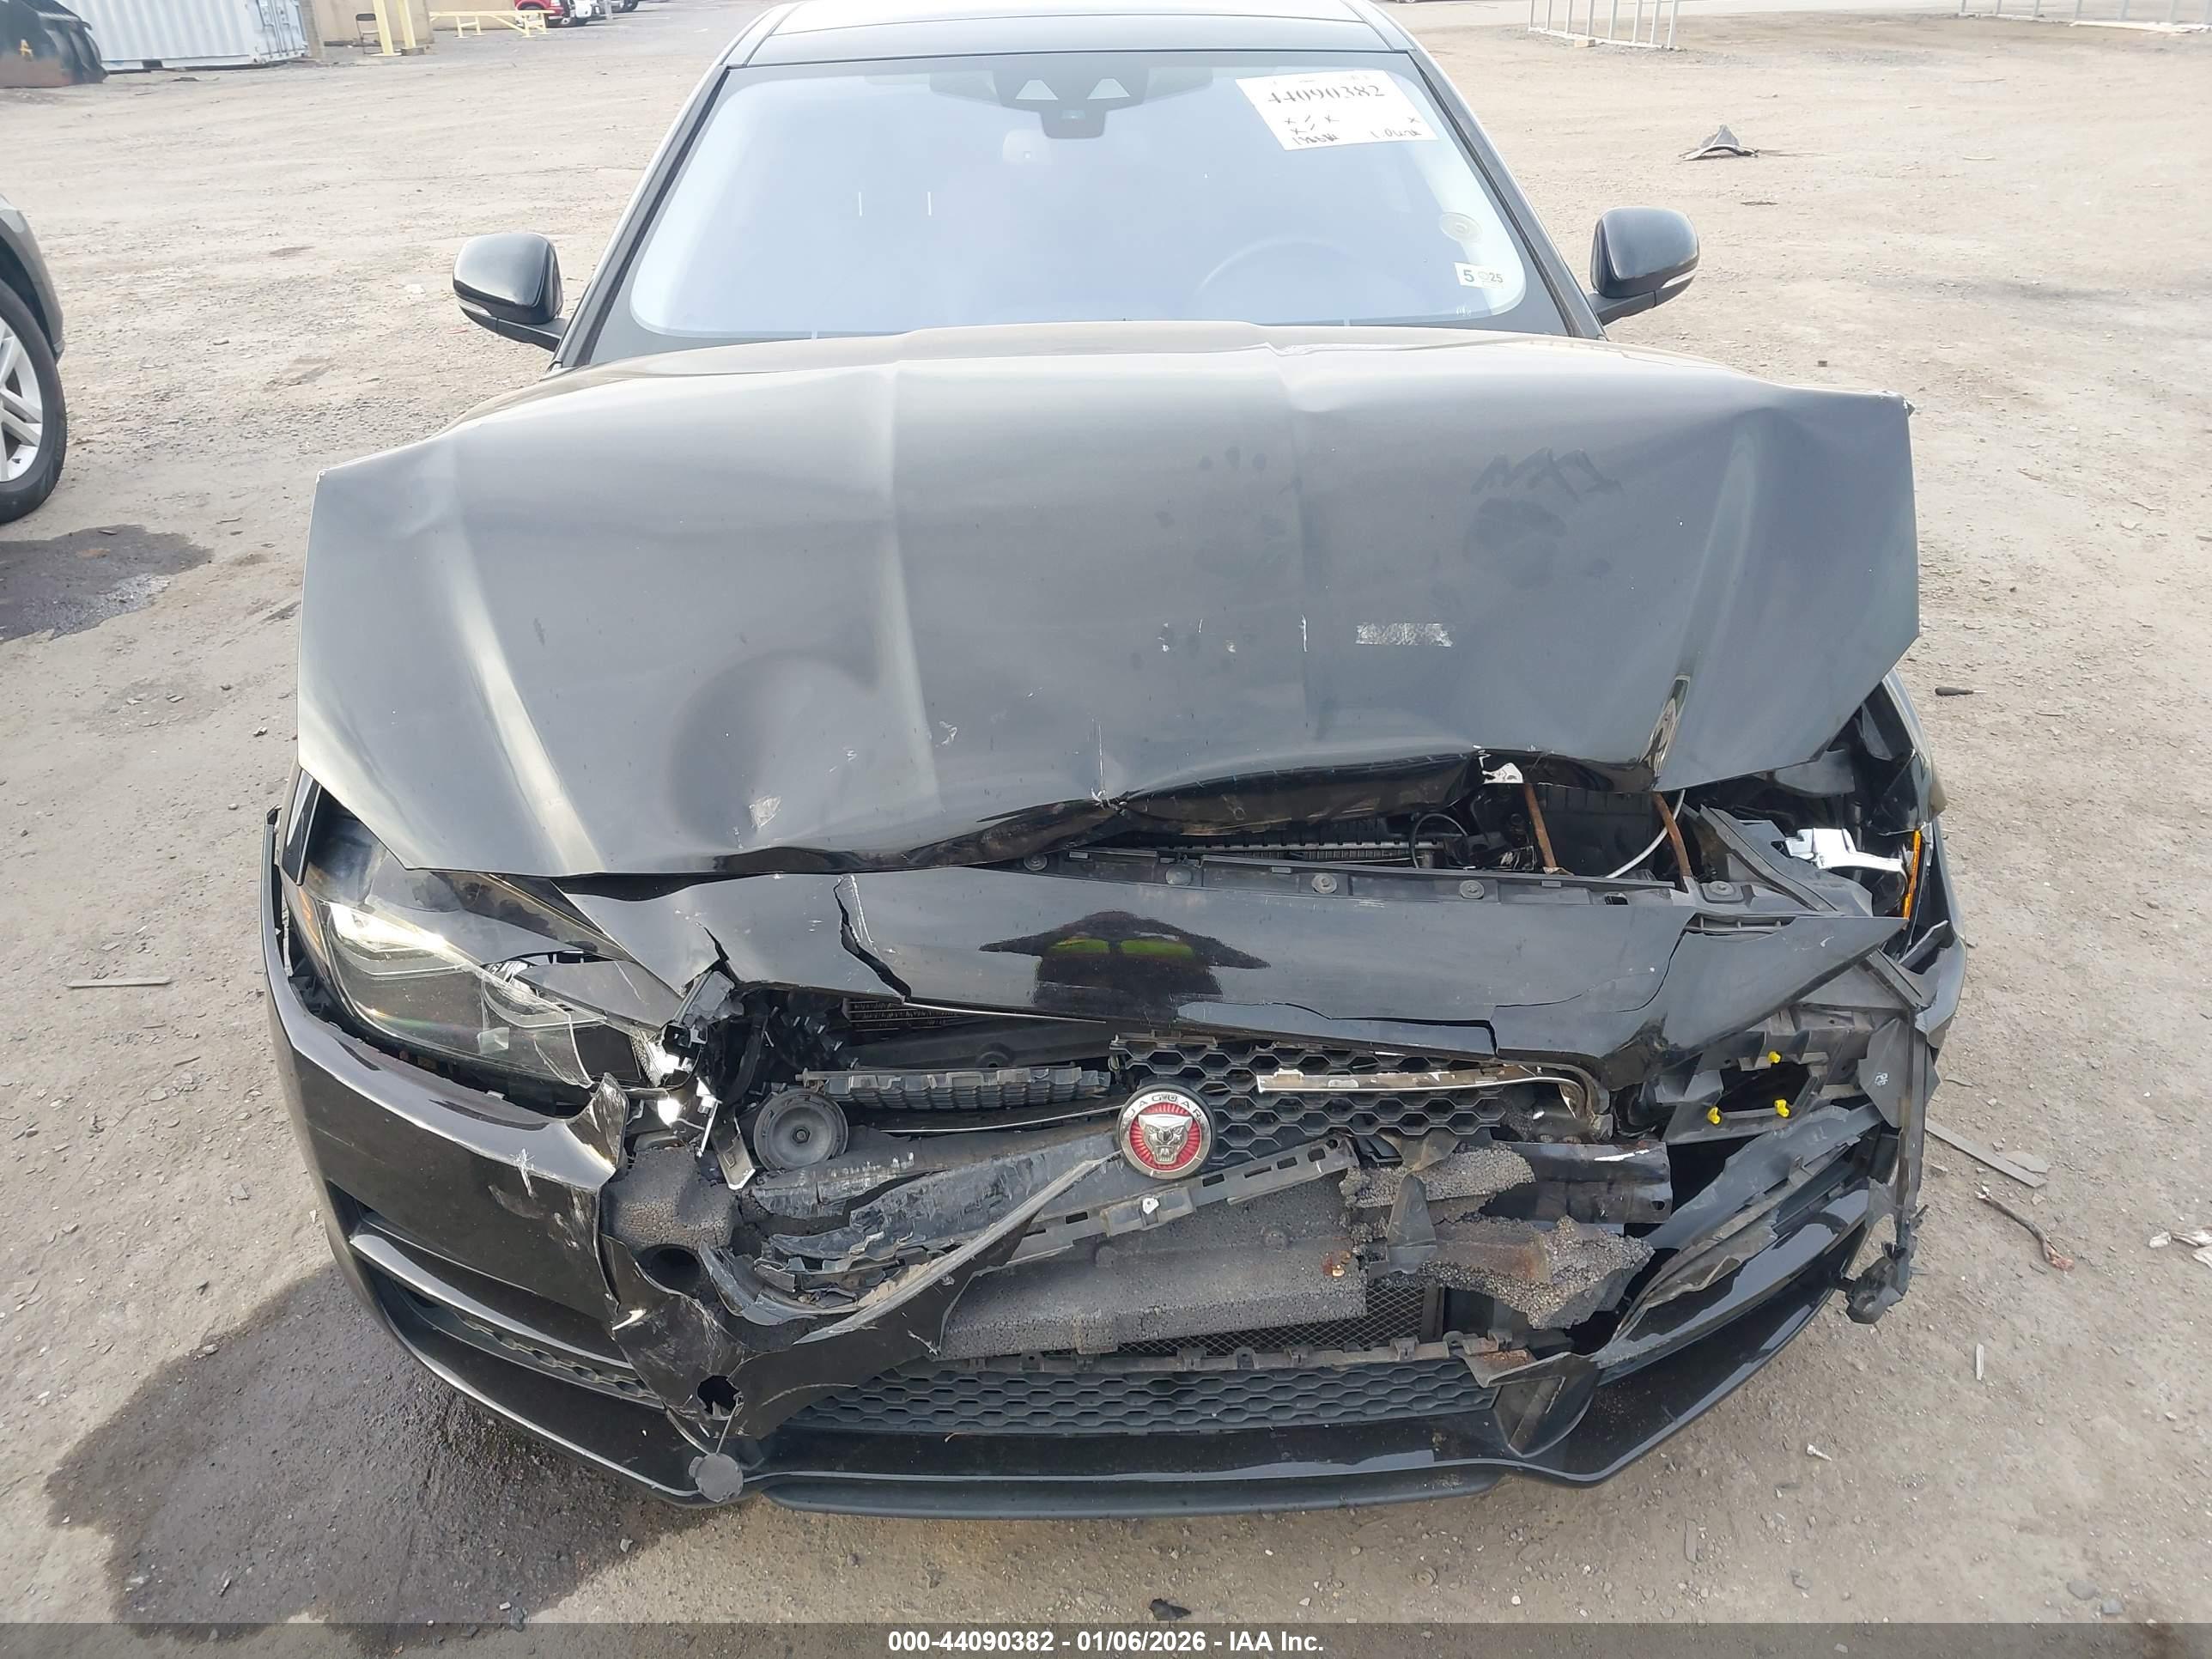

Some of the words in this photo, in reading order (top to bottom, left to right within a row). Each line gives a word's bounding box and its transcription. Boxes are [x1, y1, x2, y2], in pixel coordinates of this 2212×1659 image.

[1268, 85, 1385, 104] 44090382
[1462, 269, 1474, 283] 5
[1489, 272, 1504, 283] 25
[1128, 1094, 1203, 1121] JAGUAR
